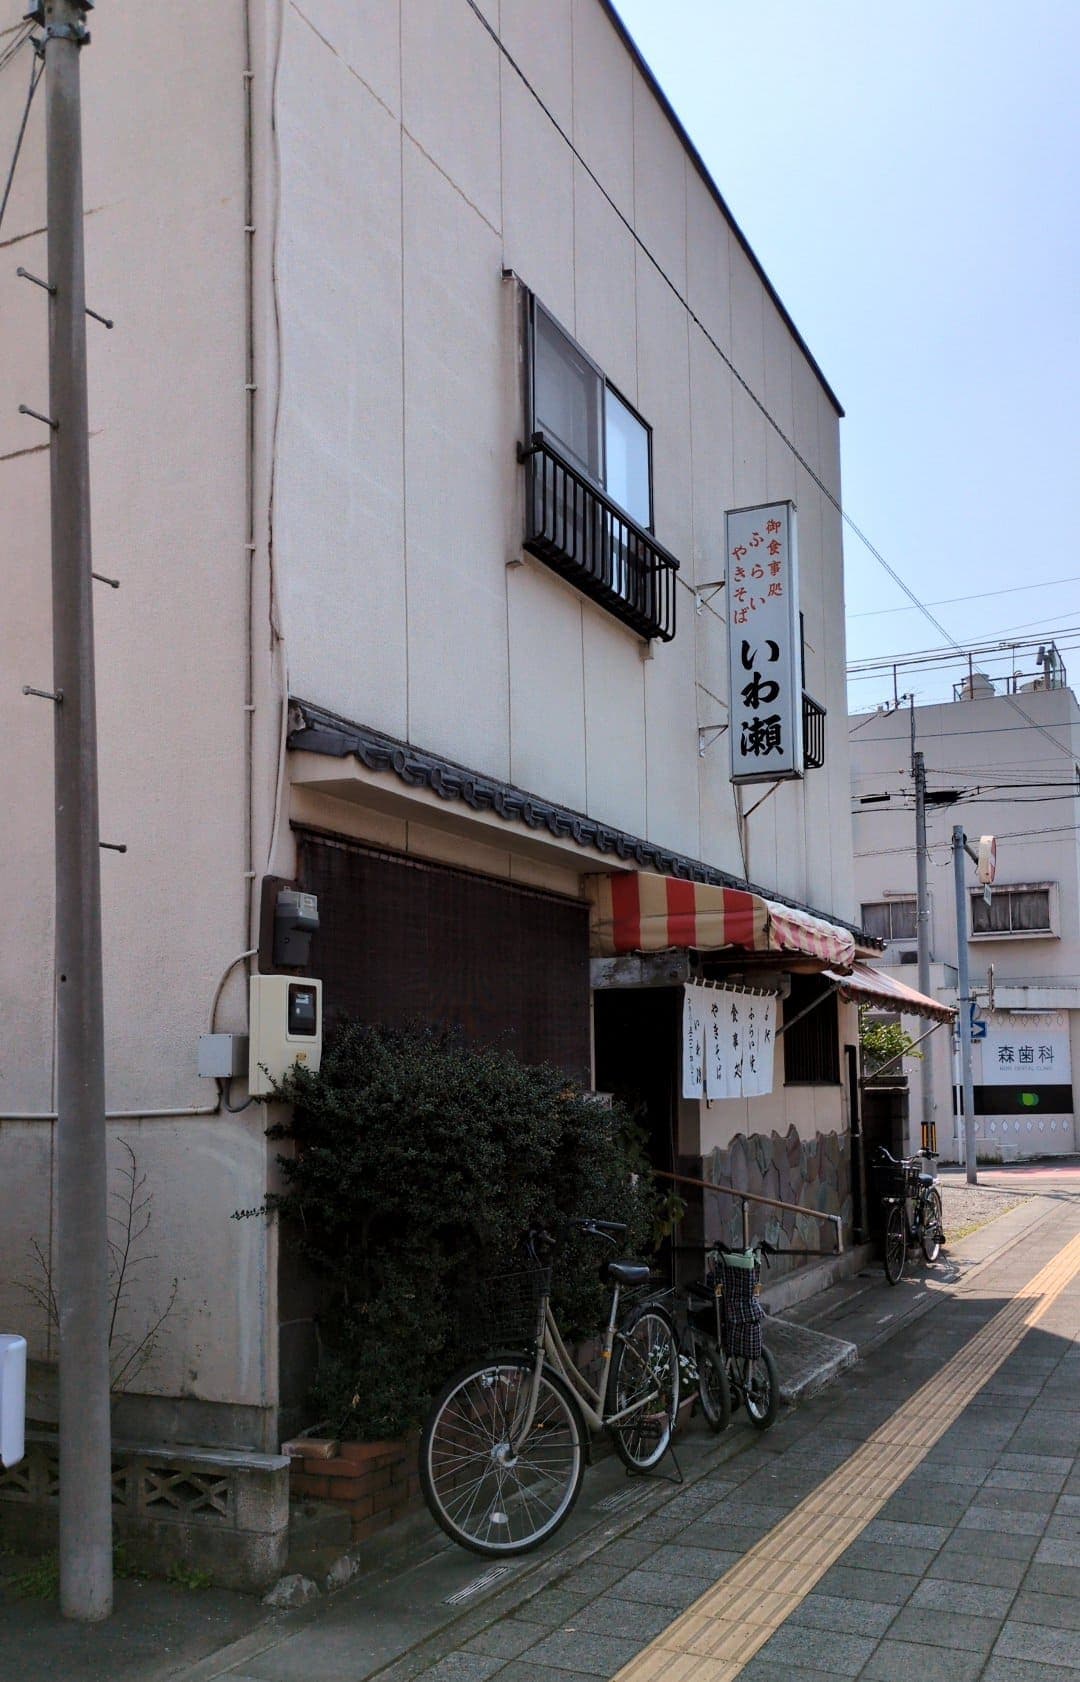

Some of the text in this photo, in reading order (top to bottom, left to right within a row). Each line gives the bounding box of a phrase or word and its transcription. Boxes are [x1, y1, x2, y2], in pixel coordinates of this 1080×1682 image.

[731, 545, 750, 625] やきそば
[749, 532, 766, 611] ふらい
[766, 519, 783, 598] 御食事処
[740, 639, 785, 757] いわ瀬
[997, 1044, 1055, 1064] 森歯科
